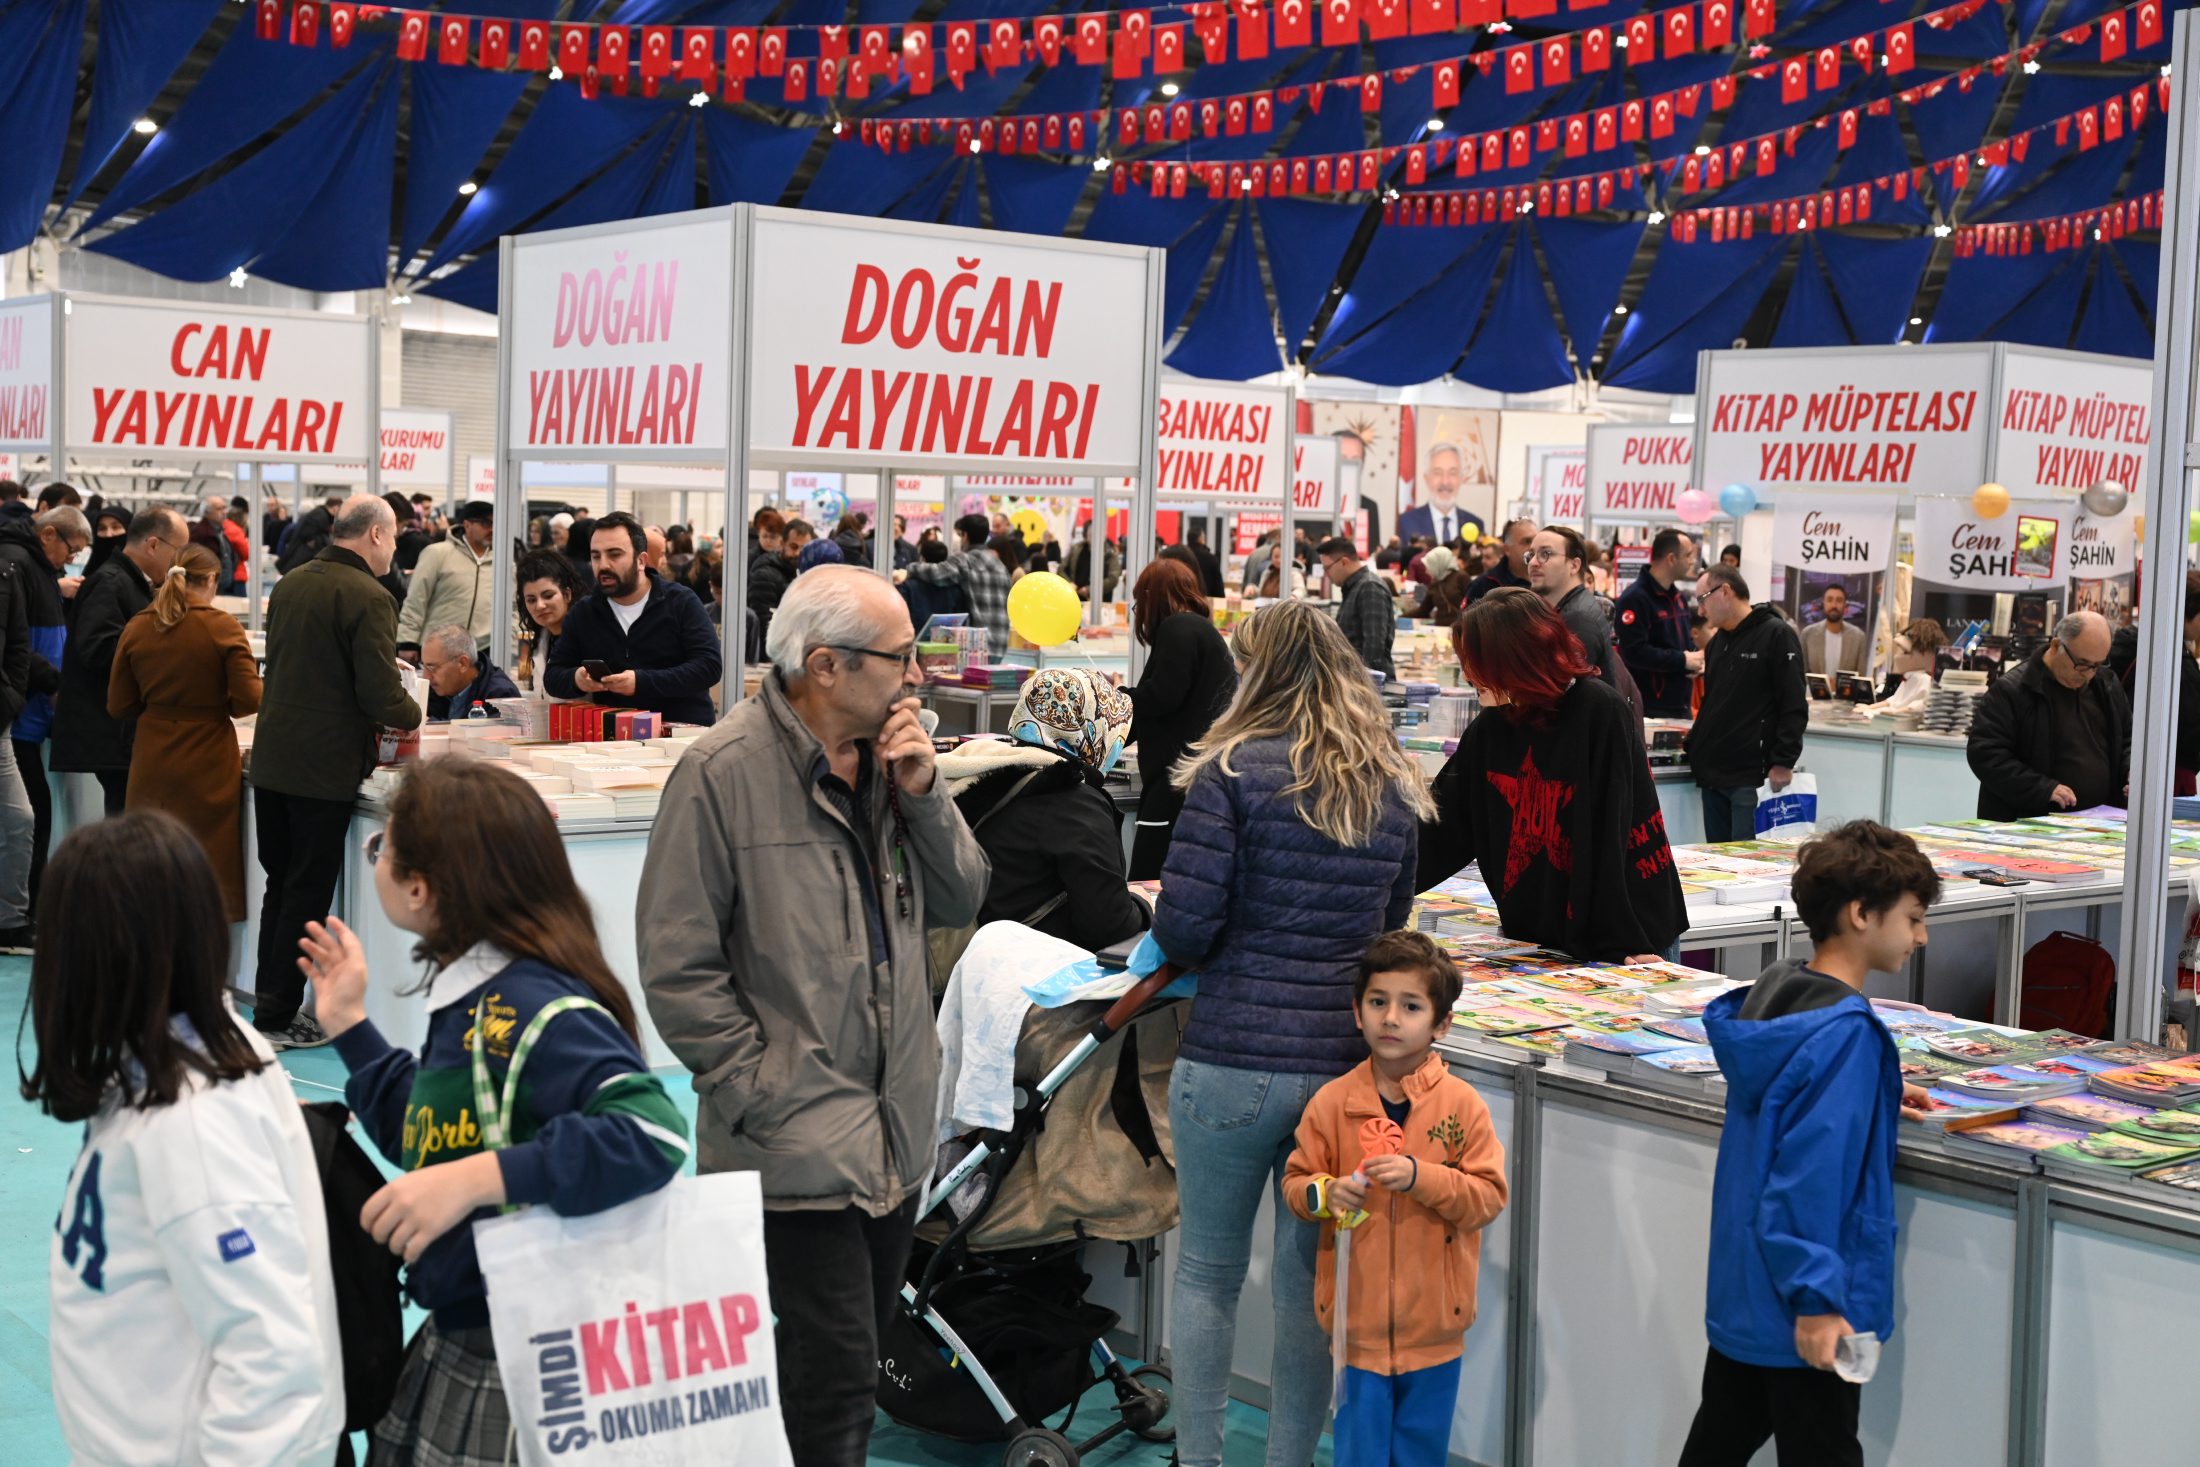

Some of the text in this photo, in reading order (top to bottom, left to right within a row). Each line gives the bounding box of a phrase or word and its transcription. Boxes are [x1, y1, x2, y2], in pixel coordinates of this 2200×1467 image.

[552, 250, 679, 349] DOĞAN
[841, 256, 1064, 359] DOĞAN
[170, 322, 272, 382] CAN
[92, 386, 345, 454] YAYINLARI
[528, 362, 704, 446] YAYINLARI
[791, 363, 1100, 460] YAYINLARI
[1158, 398, 1272, 444] BANKASI
[1802, 384, 1978, 433] MÜPTELASI
[1759, 441, 1918, 484] YAYINLARI
[1801, 536, 1869, 564] ŞAHİN
[1803, 510, 1842, 537] Cem
[1951, 523, 2005, 551] Cem
[2072, 516, 2100, 542] Cem
[1949, 550, 2022, 579] ŞAHİ
[2069, 541, 2115, 569] ŞAHİN
[416, 1105, 482, 1170] York
[579, 1292, 761, 1397] KİTAP
[529, 1328, 598, 1455] ŞİMDİ
[599, 1376, 771, 1444] OKUMA ZAMANI
